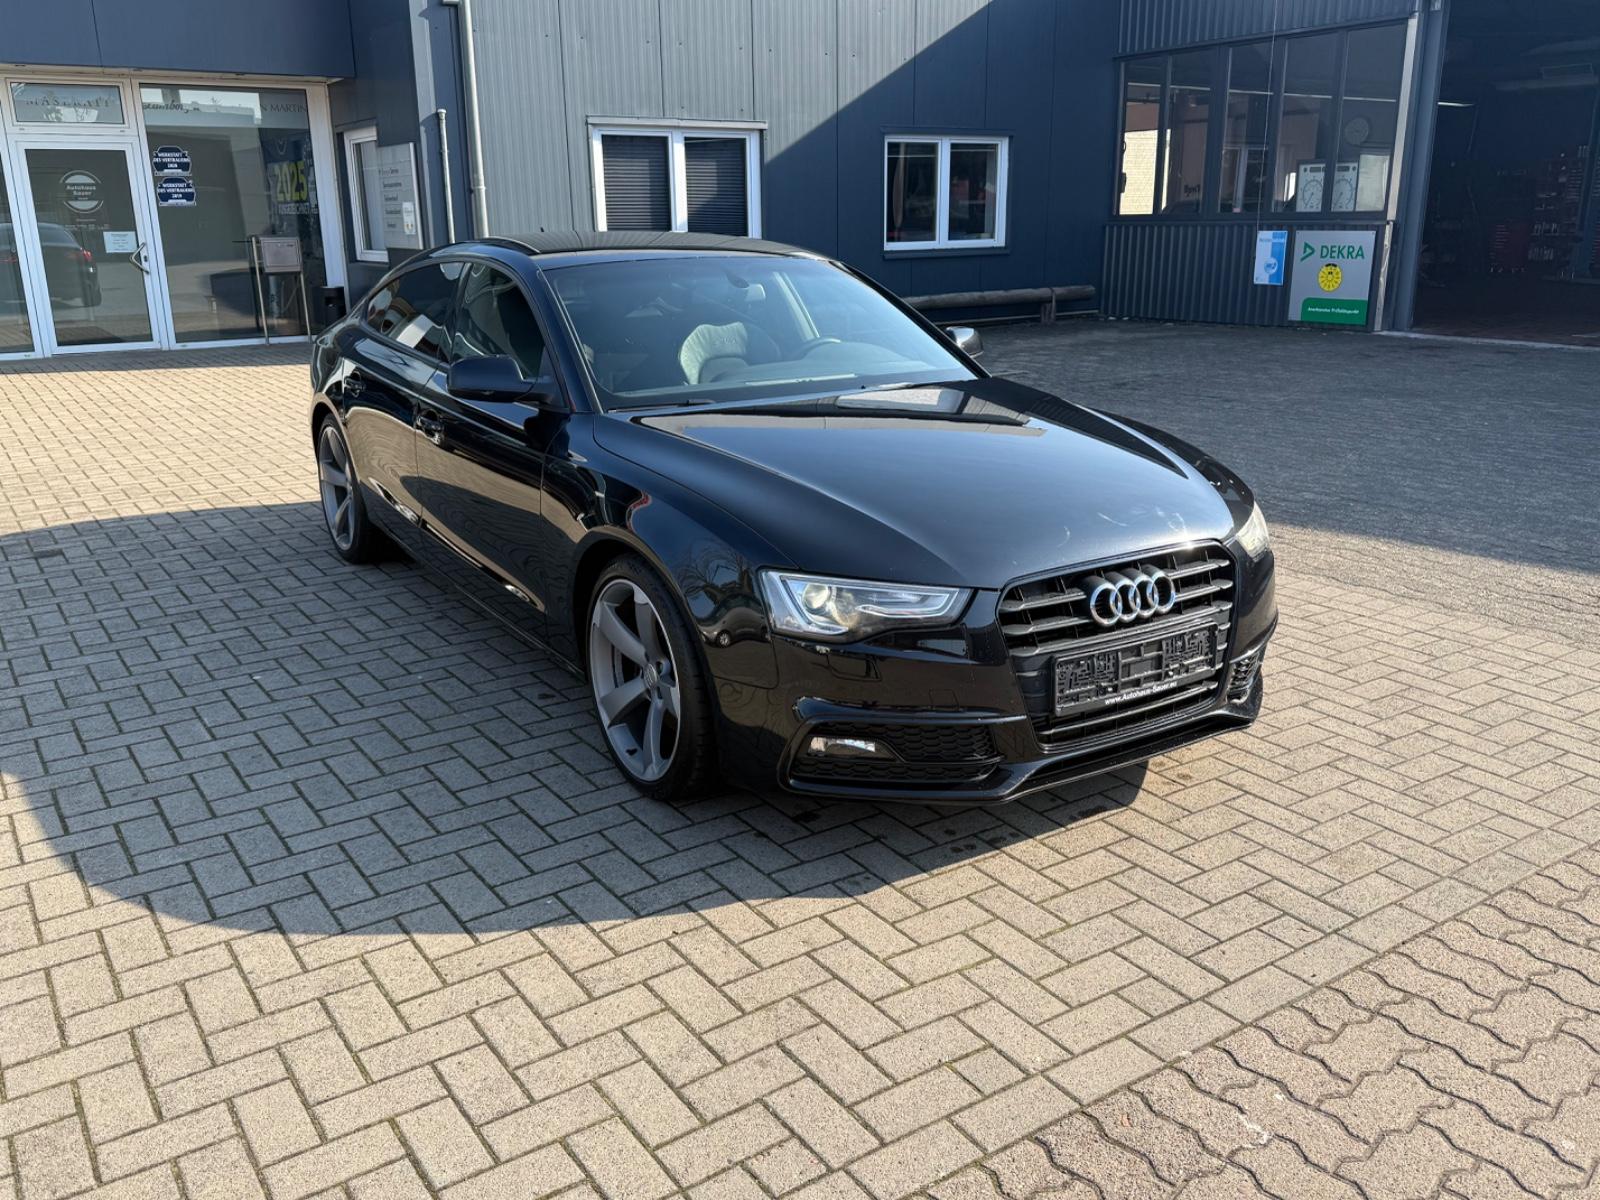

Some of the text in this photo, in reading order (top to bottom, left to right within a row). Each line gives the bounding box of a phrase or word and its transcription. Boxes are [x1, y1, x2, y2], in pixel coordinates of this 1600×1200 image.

[271, 103, 308, 113] MARTIN
[275, 160, 308, 202] 2025
[1320, 244, 1365, 259] DEKRA
